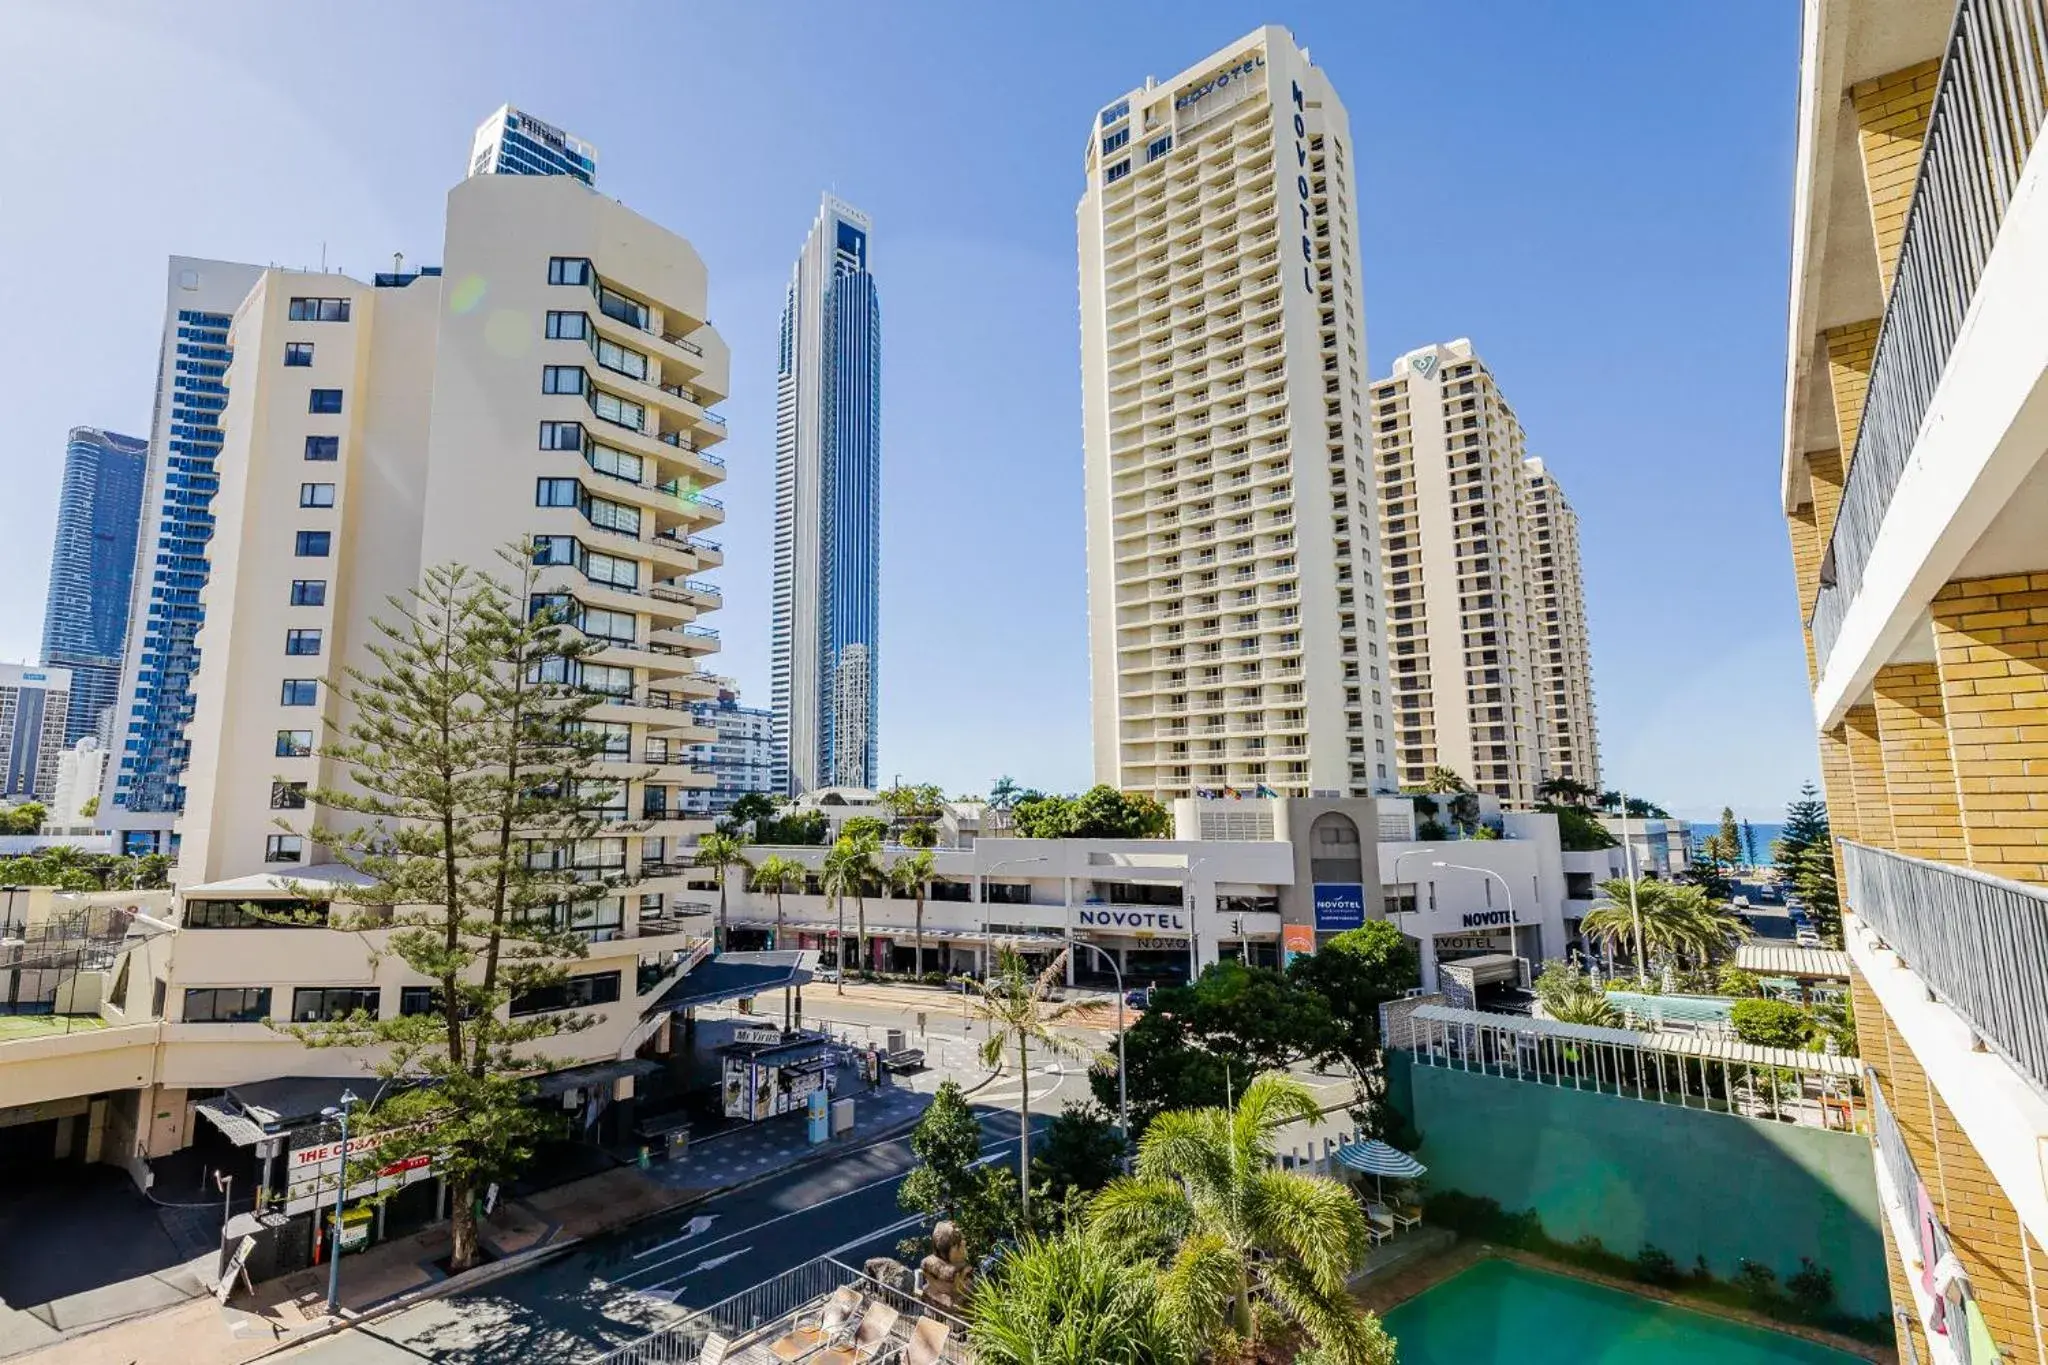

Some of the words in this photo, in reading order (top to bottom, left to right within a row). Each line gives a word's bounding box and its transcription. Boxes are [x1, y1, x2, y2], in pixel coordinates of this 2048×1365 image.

[1176, 57, 1265, 109] NOVOTEL
[1292, 80, 1313, 294] NOVOTEL
[1080, 911, 1183, 929] NOVOTEL
[1463, 910, 1520, 927] NOVOTEL
[297, 1149, 328, 1164] THE
